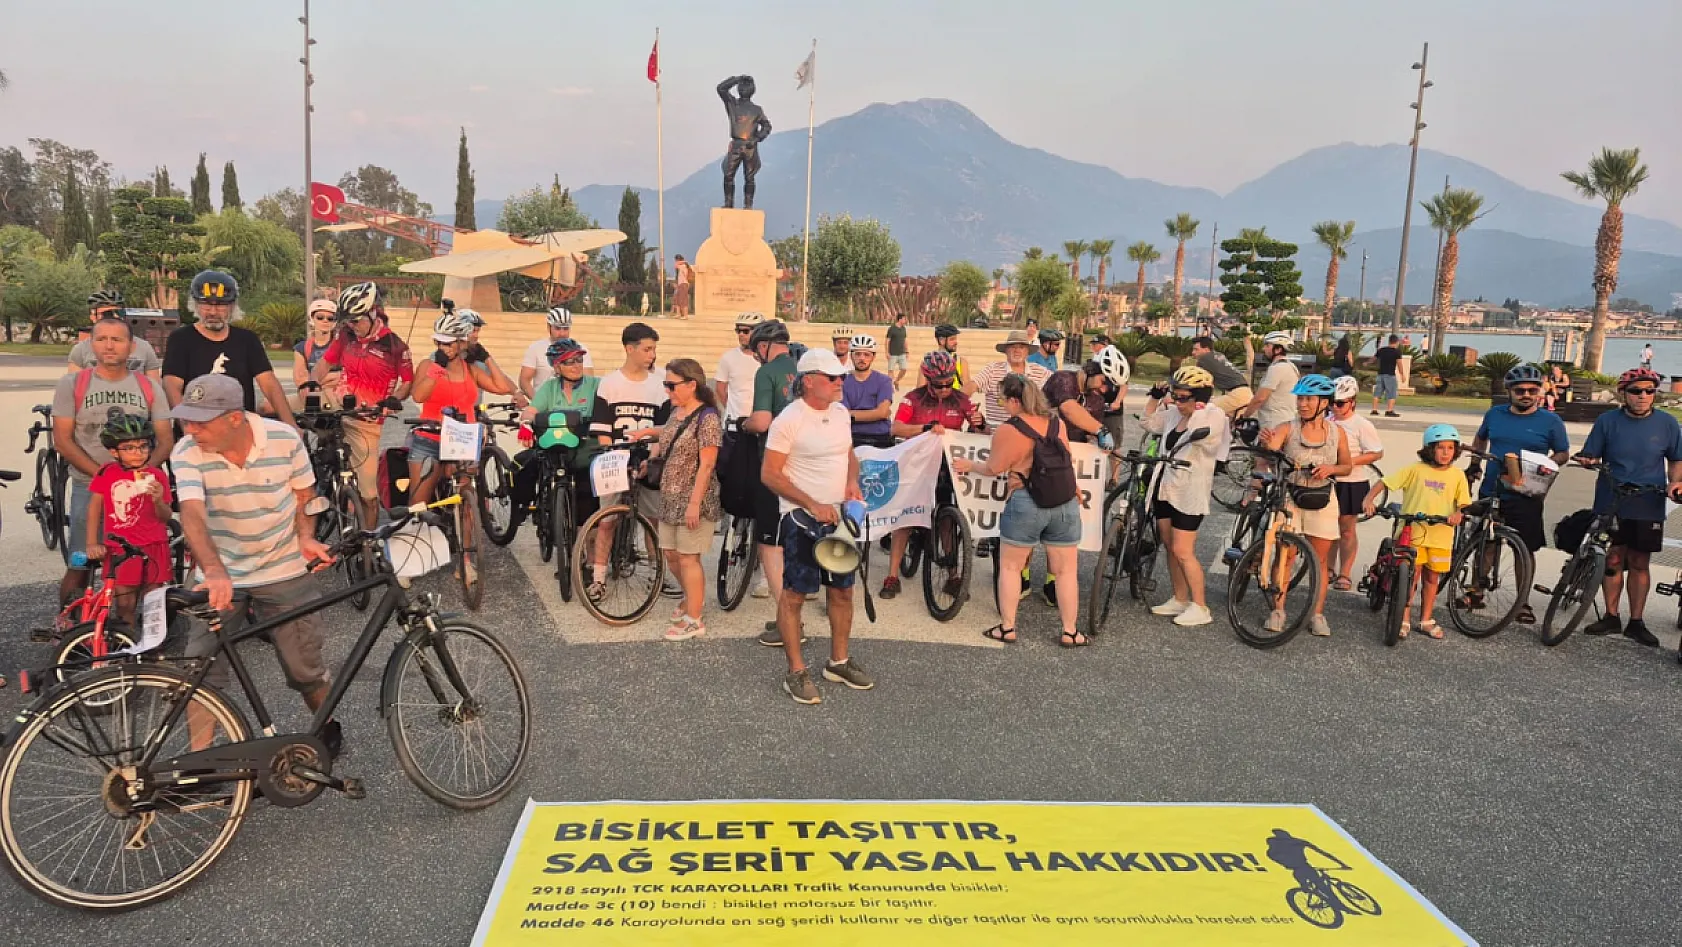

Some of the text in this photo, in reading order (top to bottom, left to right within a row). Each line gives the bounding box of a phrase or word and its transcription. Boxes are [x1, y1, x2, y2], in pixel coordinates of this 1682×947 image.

[85, 390, 146, 409] HUMMEL
[554, 819, 1017, 844] BİSİKLET TAŞITTIR,
[542, 846, 1267, 876] SAĞ ŞERİT YASAL HAKKIDIR!
[532, 882, 1008, 897] 2918 sayılı TCK KARAYOLLARI Trafik Kanununda bisiklet;
[525, 901, 590, 912] Madde
[596, 901, 615, 911] 3c
[621, 900, 655, 913] (10)
[662, 900, 706, 911] bendi
[724, 899, 777, 909] bisiklet
[783, 900, 855, 909] motorsuz
[860, 897, 880, 908] bir
[886, 898, 936, 911] taşıttır.
[521, 918, 585, 929] Madde
[591, 918, 614, 927] 46
[622, 916, 725, 930] Karayolunda
[758, 917, 785, 929] sağ
[791, 914, 833, 928] şeridi
[840, 914, 899, 925] kullanır
[928, 914, 968, 927] diğer
[974, 914, 1026, 926] taşıtlar
[1031, 914, 1051, 925] ile
[1056, 917, 1088, 926] aynı
[1094, 914, 1194, 925] sorumlulukla
[1196, 914, 1257, 925] hareket
[1261, 914, 1294, 925] eder
